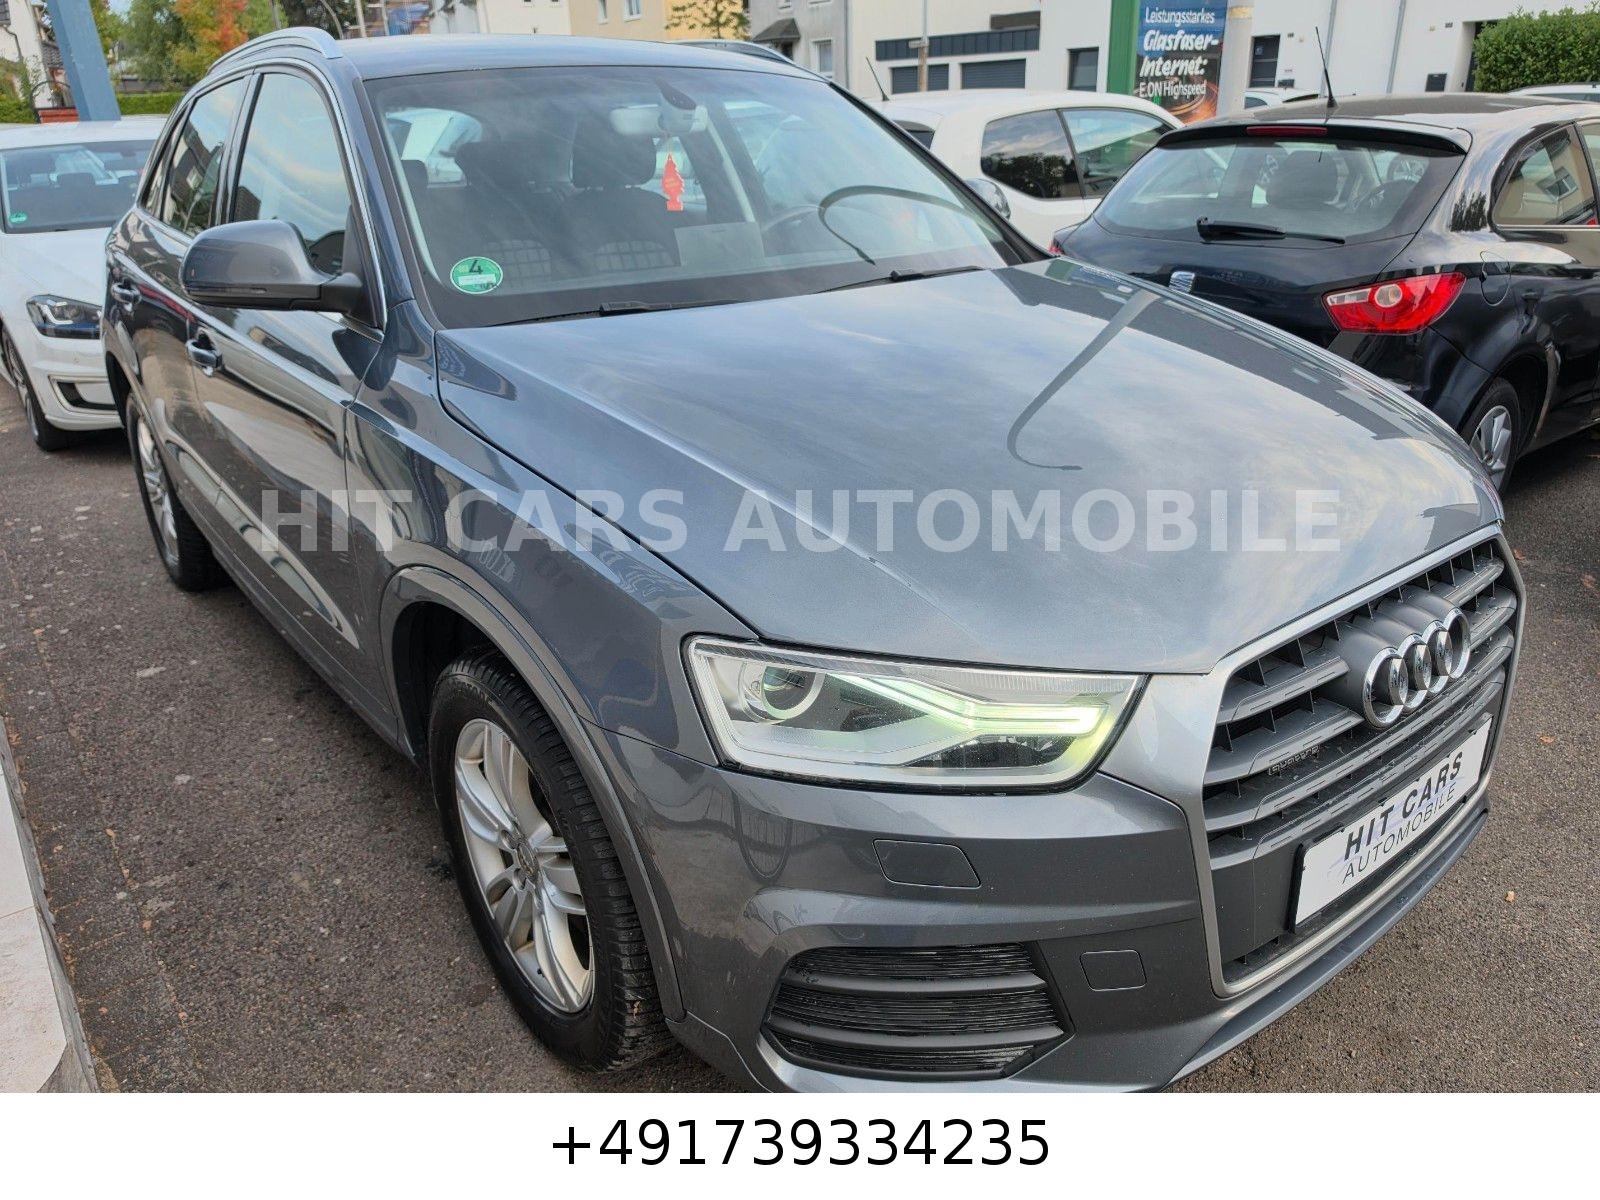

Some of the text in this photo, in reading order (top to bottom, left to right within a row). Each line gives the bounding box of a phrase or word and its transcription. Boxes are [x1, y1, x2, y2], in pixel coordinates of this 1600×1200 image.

[1145, 7, 1215, 27] Leistungsstarkes
[1143, 29, 1219, 51] Glasfaser-
[1139, 56, 1208, 77] Internet:
[1139, 80, 1207, 99] E.ON Highspeed
[469, 259, 483, 274] 4
[1344, 752, 1463, 861] HIT CARS
[1342, 782, 1457, 884] AUTOMOBILE
